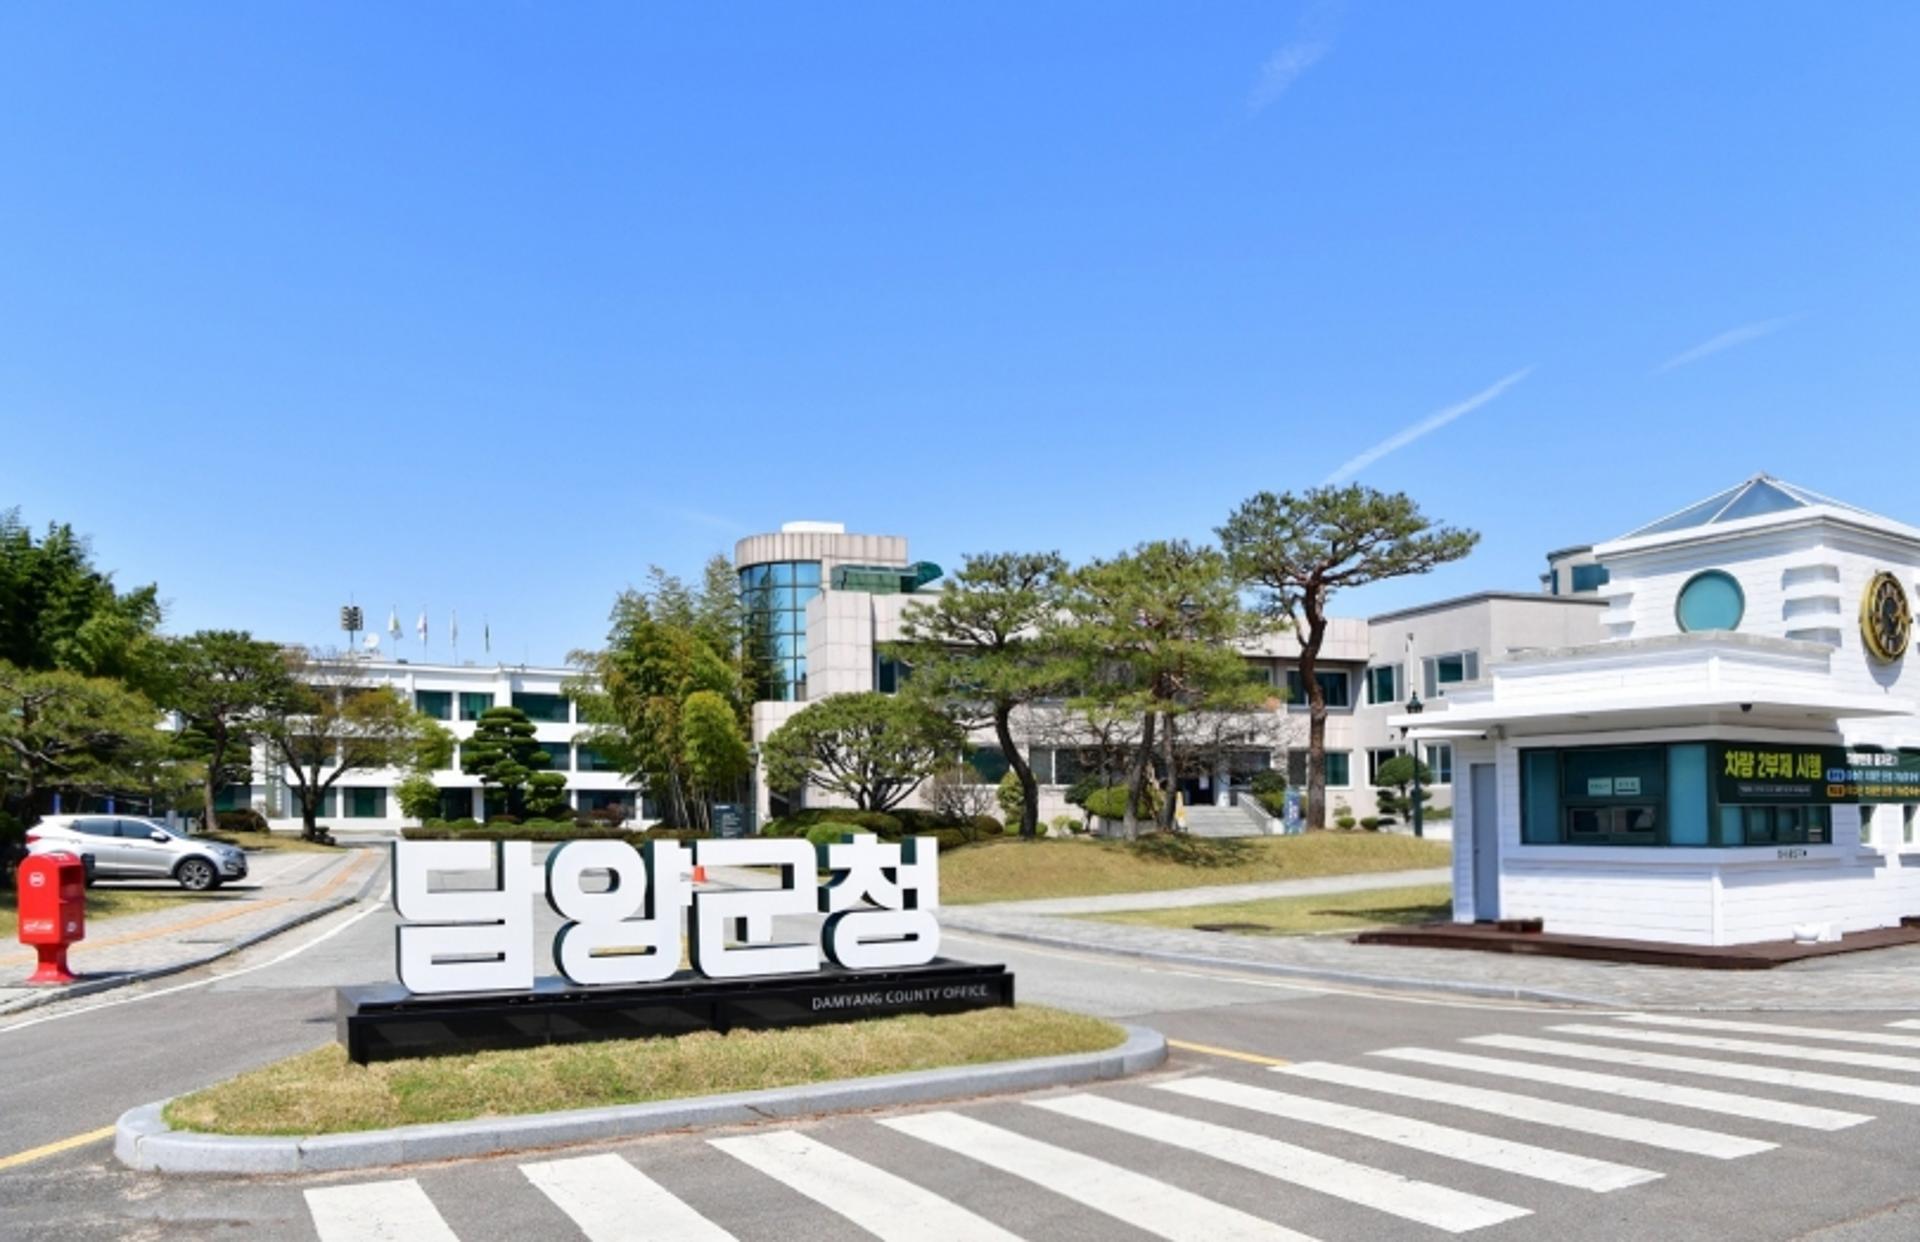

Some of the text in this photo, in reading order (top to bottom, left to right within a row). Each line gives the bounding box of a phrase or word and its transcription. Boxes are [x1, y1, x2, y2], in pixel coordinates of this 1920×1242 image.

[1725, 750, 1755, 778] 차량
[1758, 752, 1792, 778] 2부제
[1796, 753, 1821, 779] 시행
[392, 833, 940, 994] 담양군청
[812, 984, 988, 1010] DAMYANG COUNTY OFFICE
